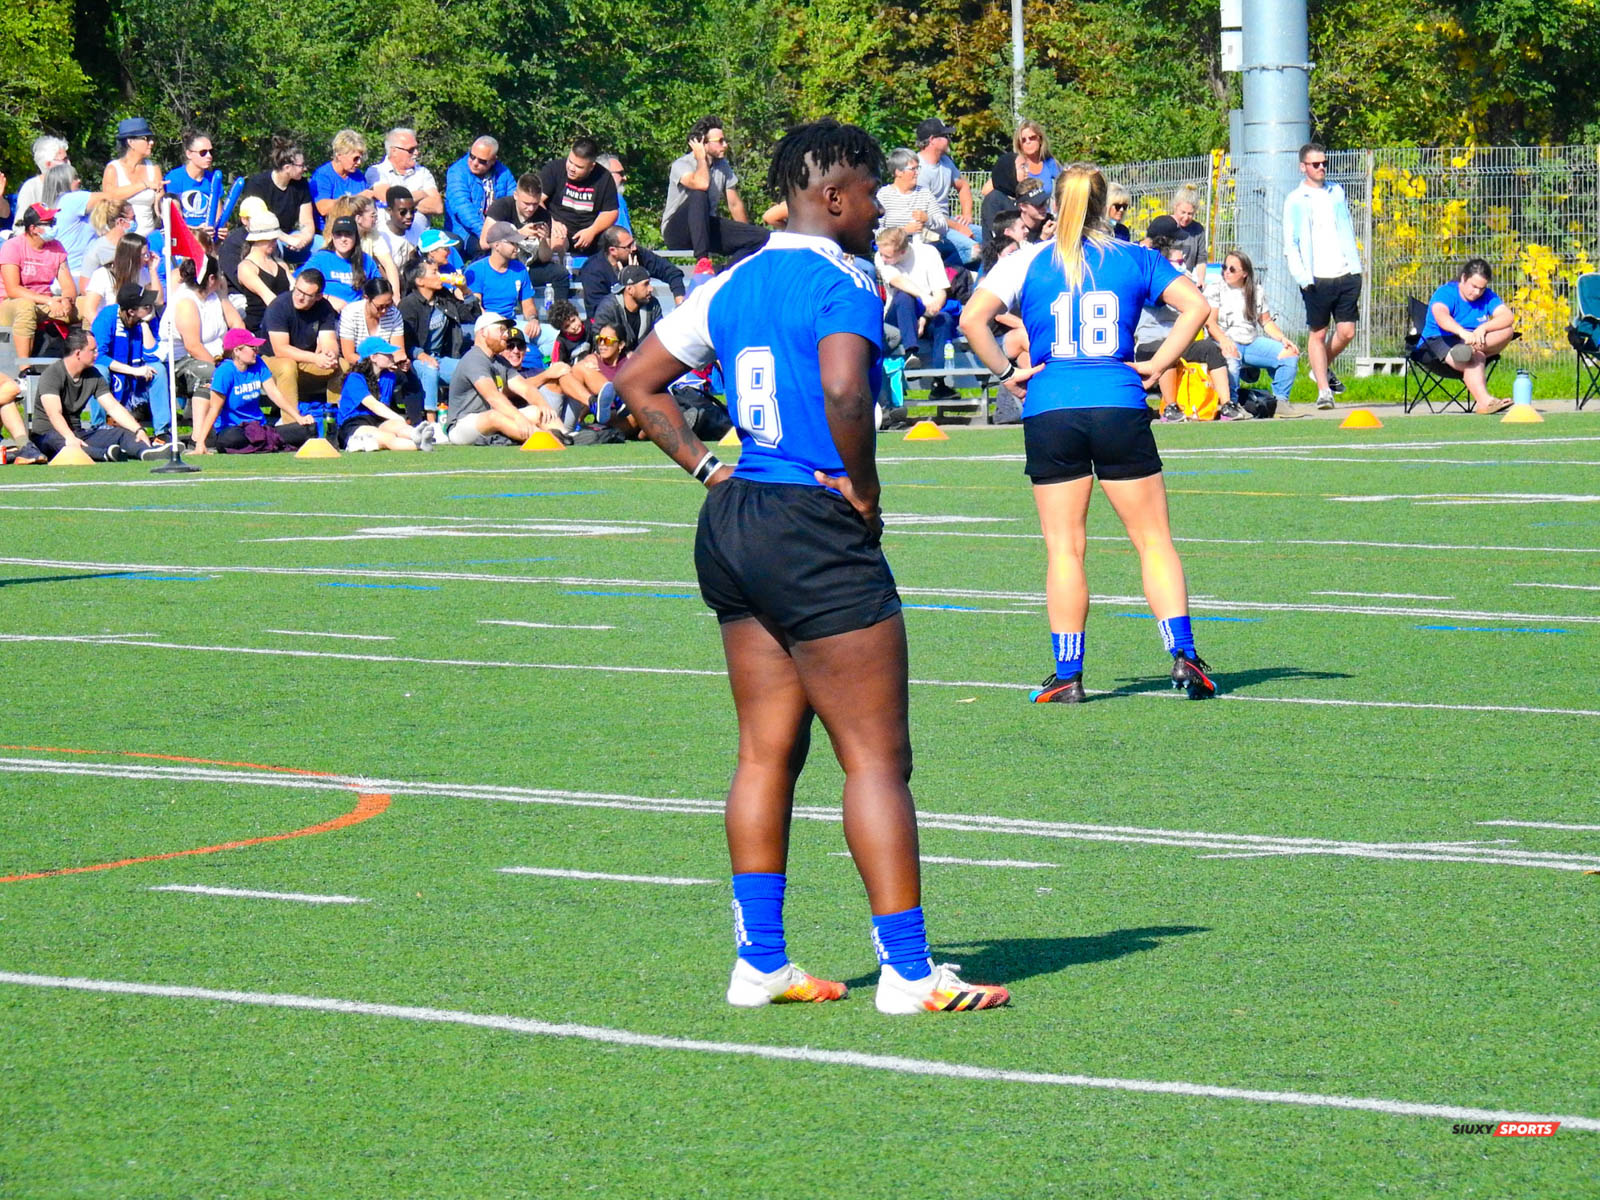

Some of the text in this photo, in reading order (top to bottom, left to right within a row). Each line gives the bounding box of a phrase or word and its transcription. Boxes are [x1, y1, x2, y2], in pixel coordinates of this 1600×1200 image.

[565, 188, 592, 200] HURLEY
[511, 328, 518, 337] P
[1050, 291, 1119, 357] 18
[735, 346, 783, 449] 8
